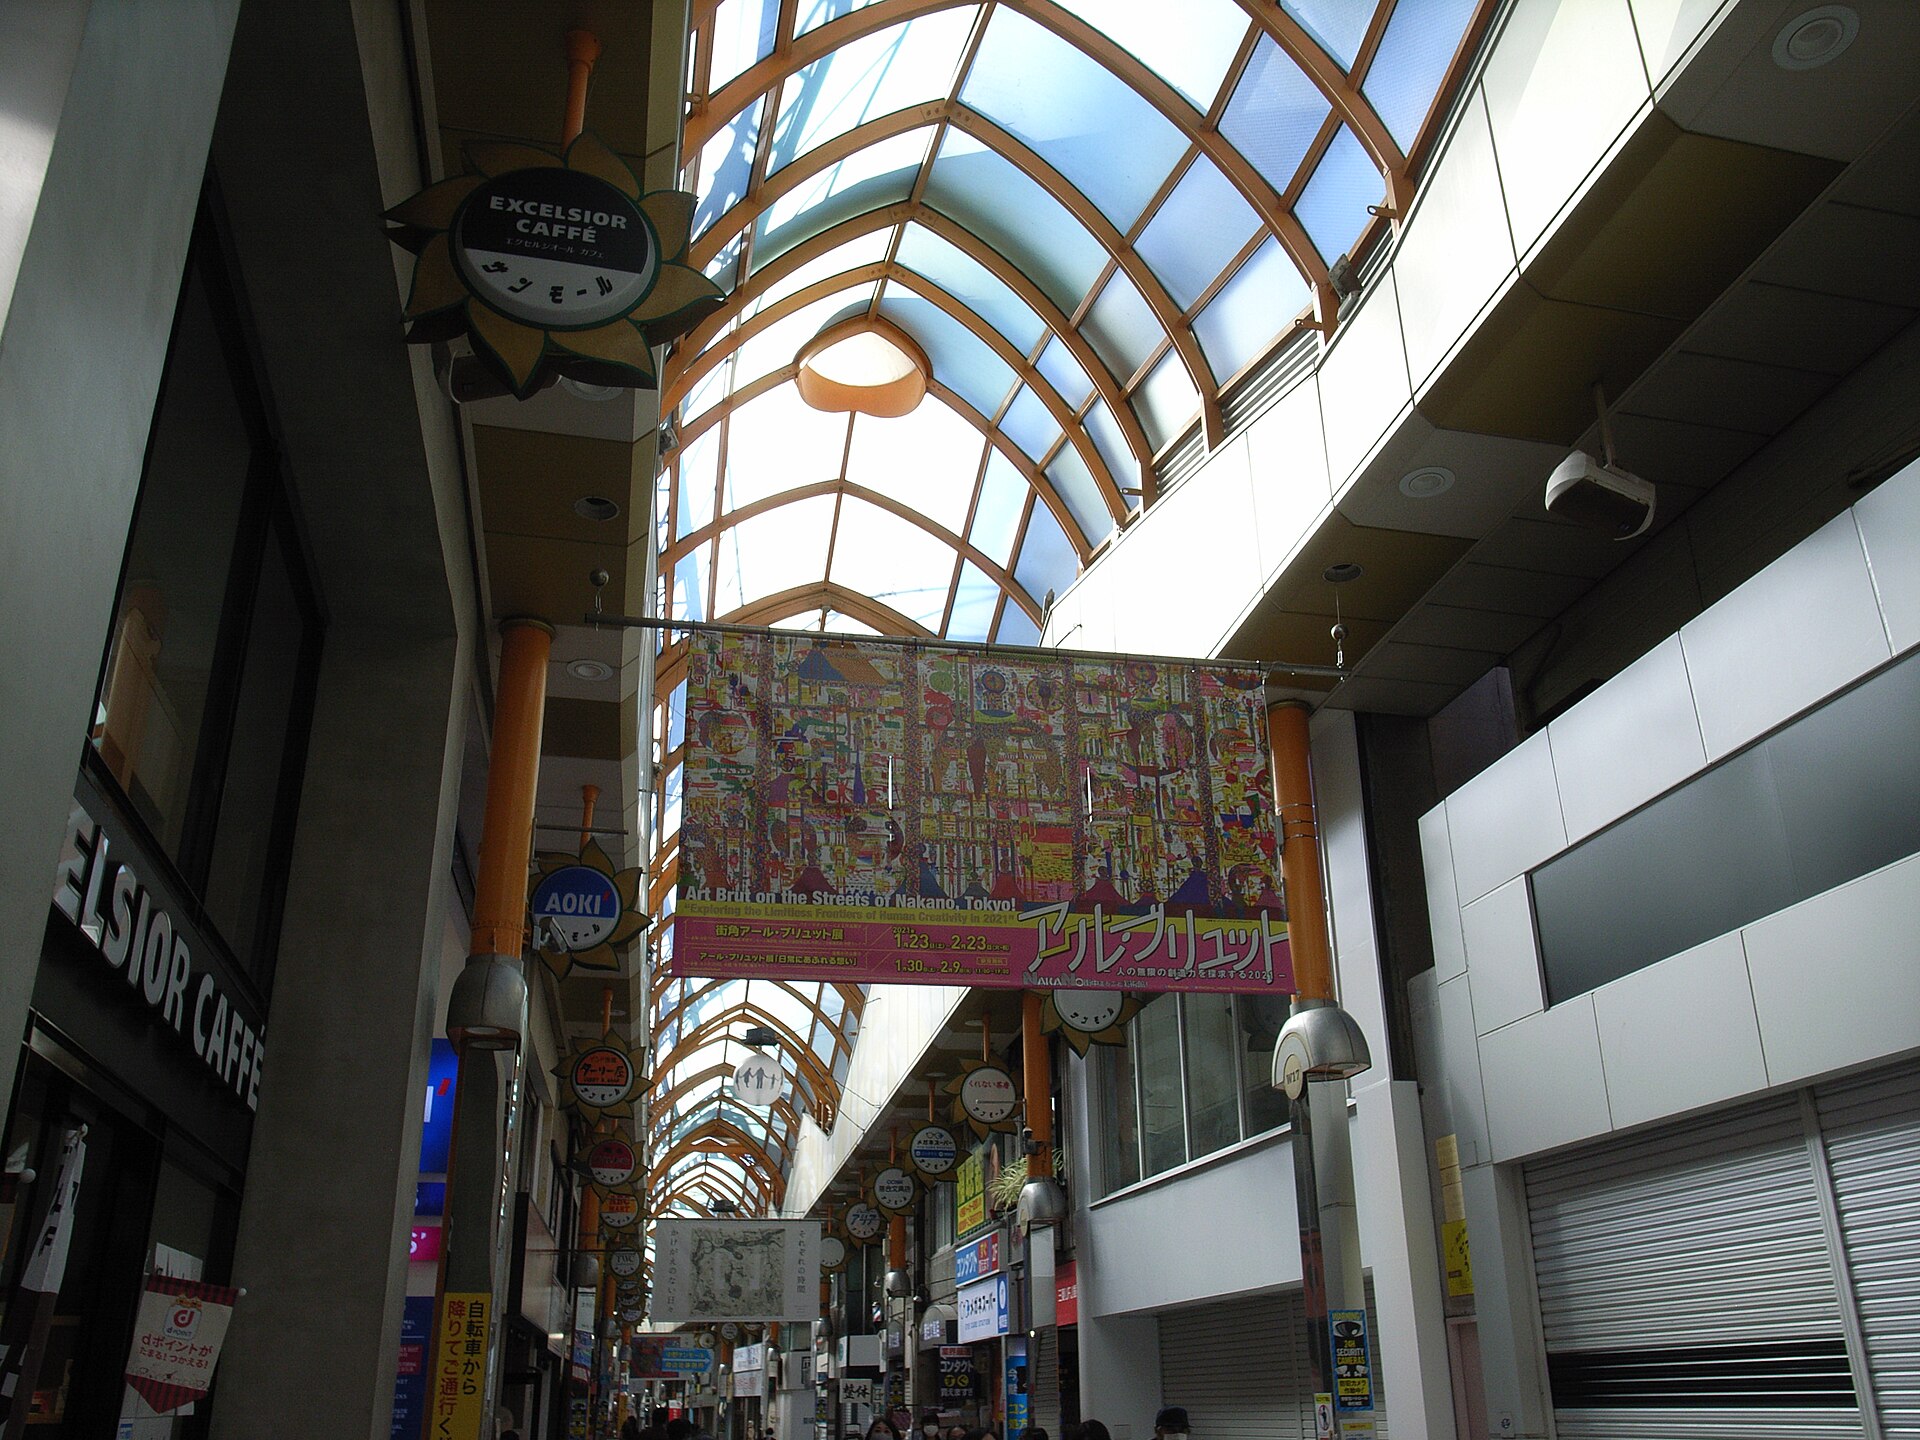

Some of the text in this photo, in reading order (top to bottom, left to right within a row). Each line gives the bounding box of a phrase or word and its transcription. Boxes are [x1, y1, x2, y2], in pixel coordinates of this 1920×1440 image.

[489, 195, 628, 230] EXCELSIOR
[515, 218, 598, 244] CAFFÉ
[482, 261, 613, 304] サンモール
[544, 892, 602, 915] AOKI
[685, 886, 1016, 912] Art Brut on the Streets of Nakano, Tokyo!
[744, 905, 762, 916] the
[764, 906, 812, 918] Limitless
[815, 908, 863, 920] Frontiers
[866, 910, 876, 920] of
[880, 911, 915, 921] Human
[919, 912, 967, 924] Creativity
[970, 913, 979, 923] in
[1070, 1008, 1114, 1024] サンモール
[142, 1333, 214, 1358] dポイントが
[462, 1301, 485, 1395] 自転車から
[1336, 1348, 1364, 1356] SECURITY
[940, 1360, 975, 1373] コンタクト
[1337, 1356, 1366, 1365] CAMERAS
[842, 1382, 870, 1400] 整体
[944, 1374, 970, 1387] すぐ
